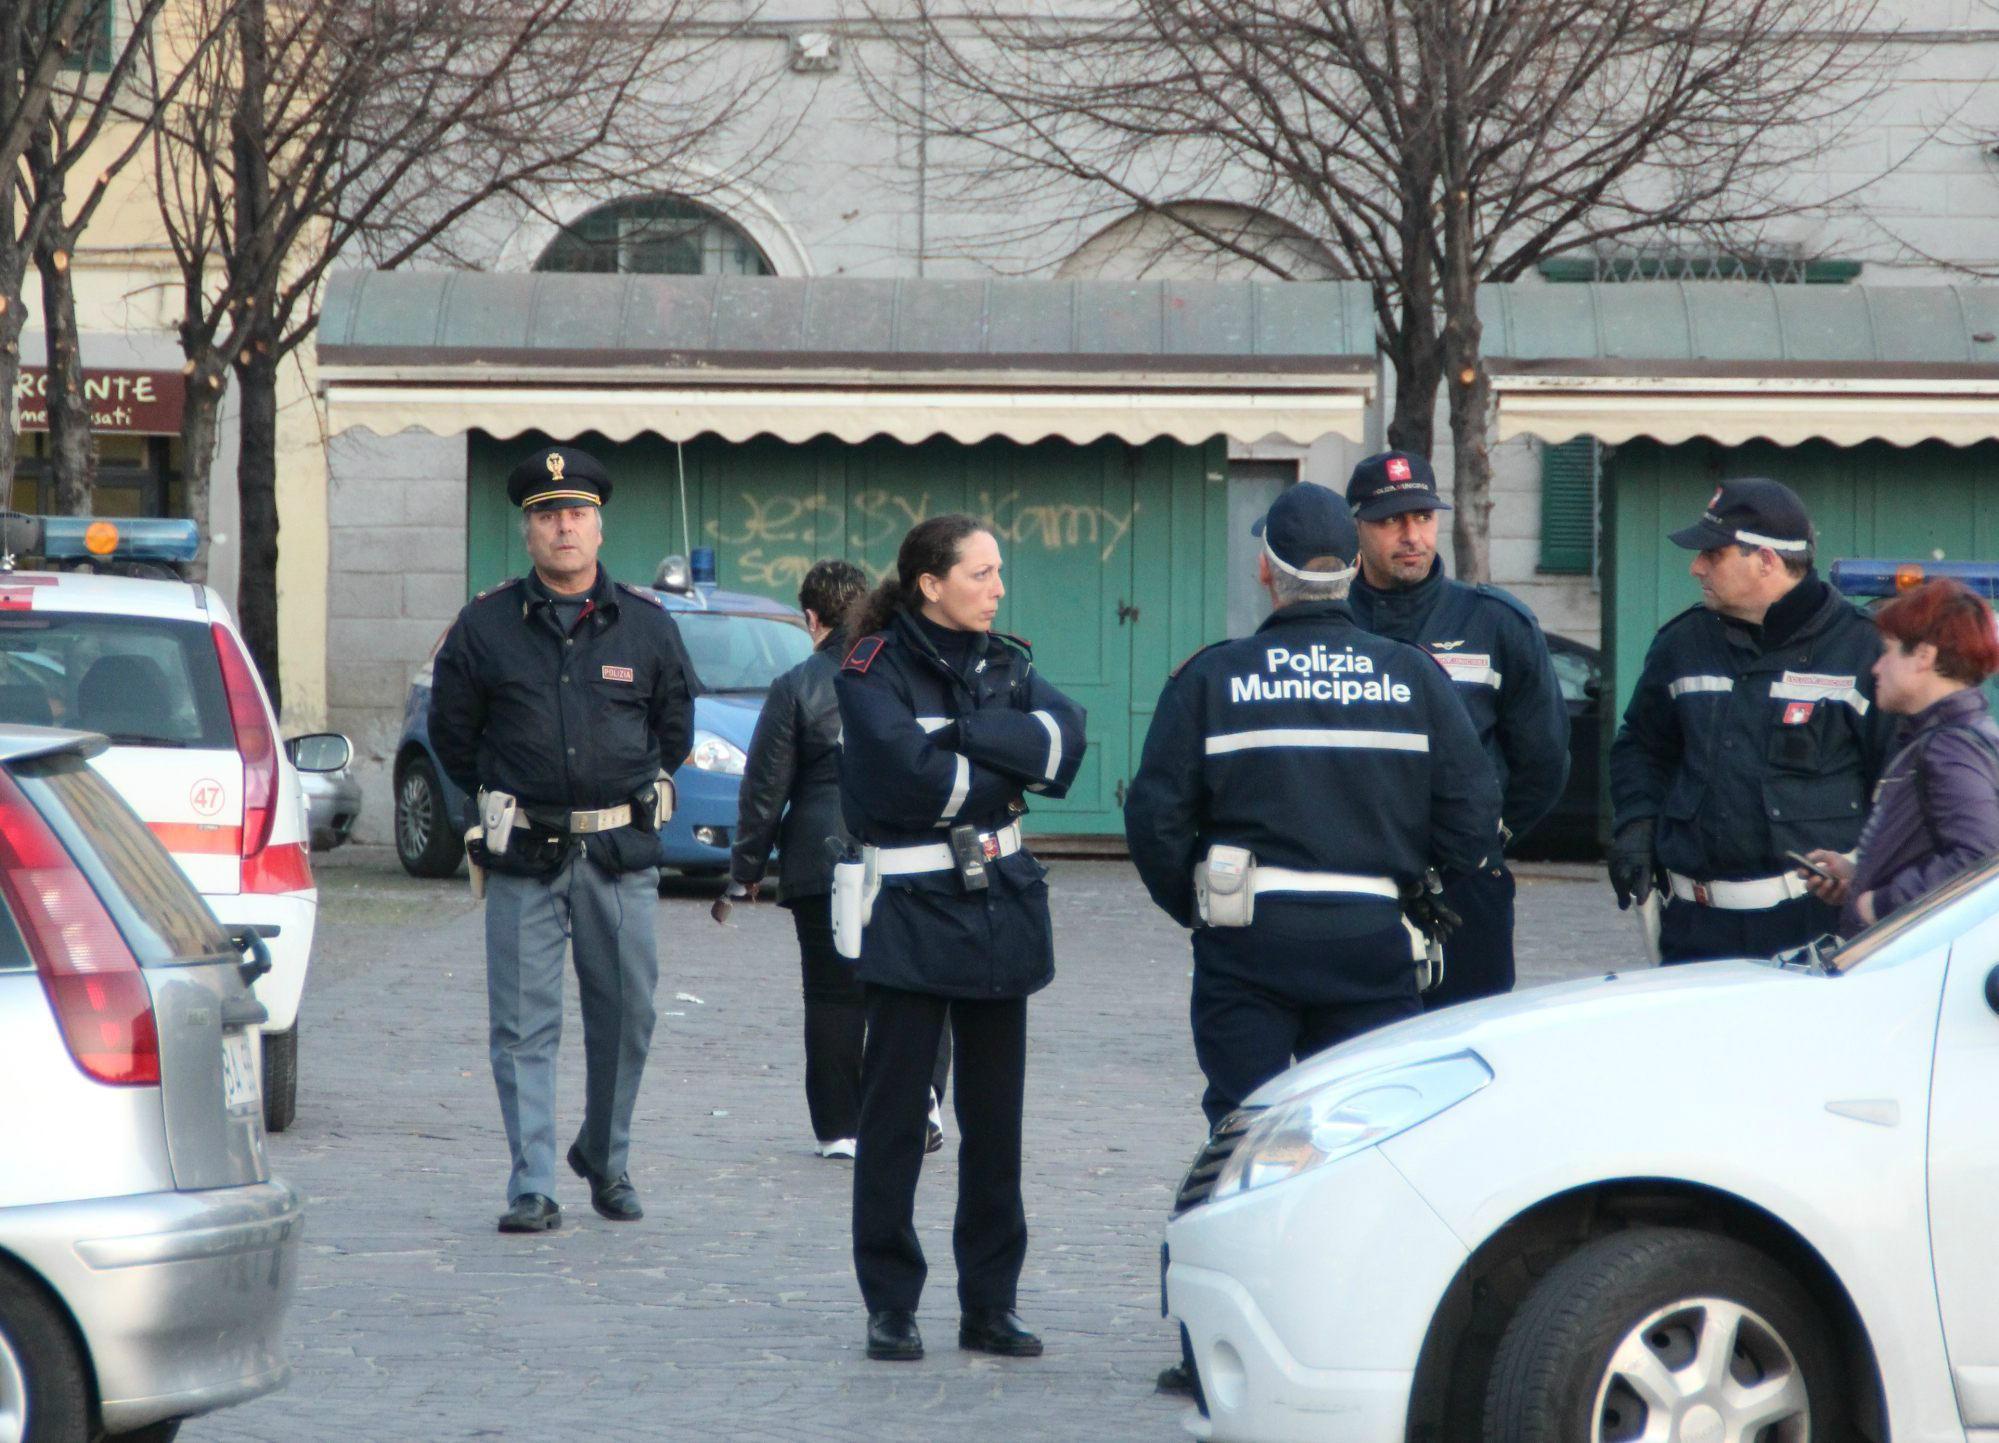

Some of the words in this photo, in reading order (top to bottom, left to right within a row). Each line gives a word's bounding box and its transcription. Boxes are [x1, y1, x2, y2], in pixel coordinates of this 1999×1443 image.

[1266, 645, 1374, 673] Polizia
[604, 667, 631, 679] POLIZIA
[1231, 672, 1412, 705] Municipale
[194, 787, 219, 808] 47
